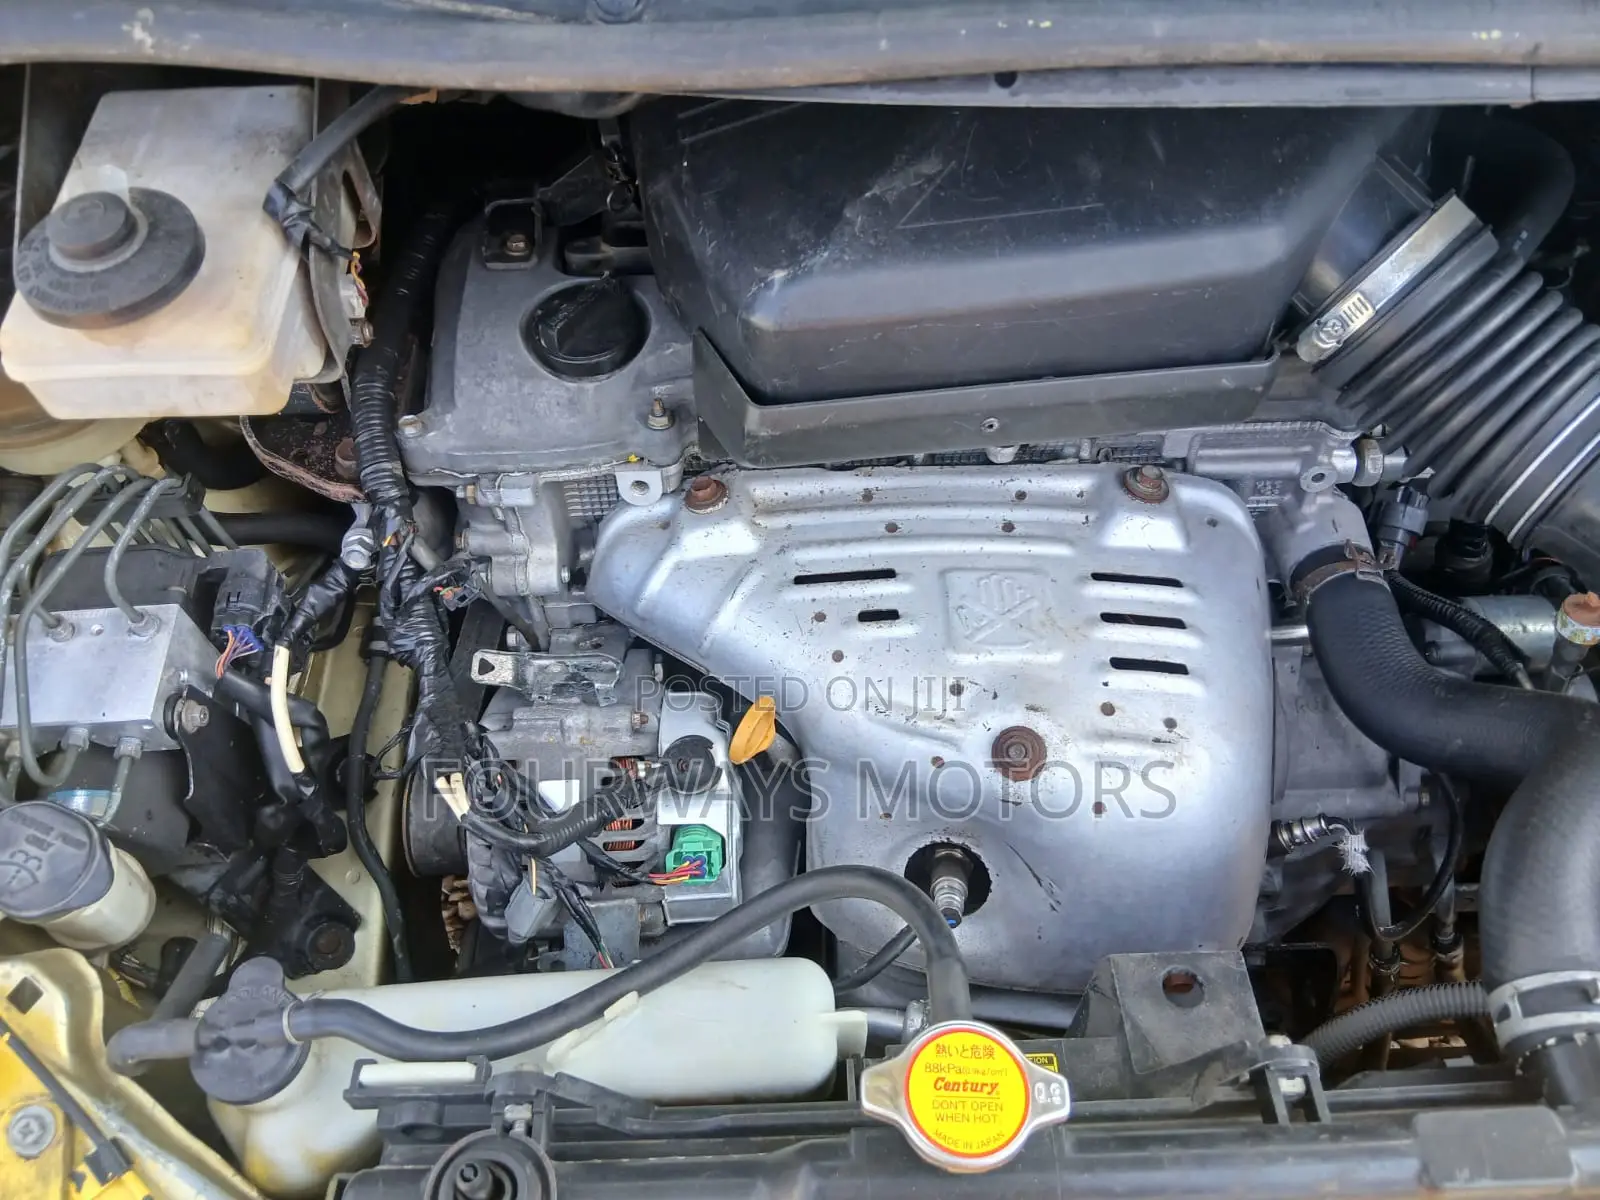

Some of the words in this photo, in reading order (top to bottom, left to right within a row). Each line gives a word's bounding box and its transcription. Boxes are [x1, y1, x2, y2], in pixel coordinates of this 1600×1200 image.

[935, 1043, 996, 1061] 熱いと危険
[933, 1076, 999, 1095] Century
[932, 1099, 969, 1110] DON'T
[970, 1101, 1004, 1112] OPEN
[935, 1112, 971, 1123] WHEN
[973, 1114, 999, 1124] HOT
[934, 1129, 960, 1147] MADE
[962, 1140, 974, 1150] IN
[975, 1131, 1005, 1149] JAPAN
